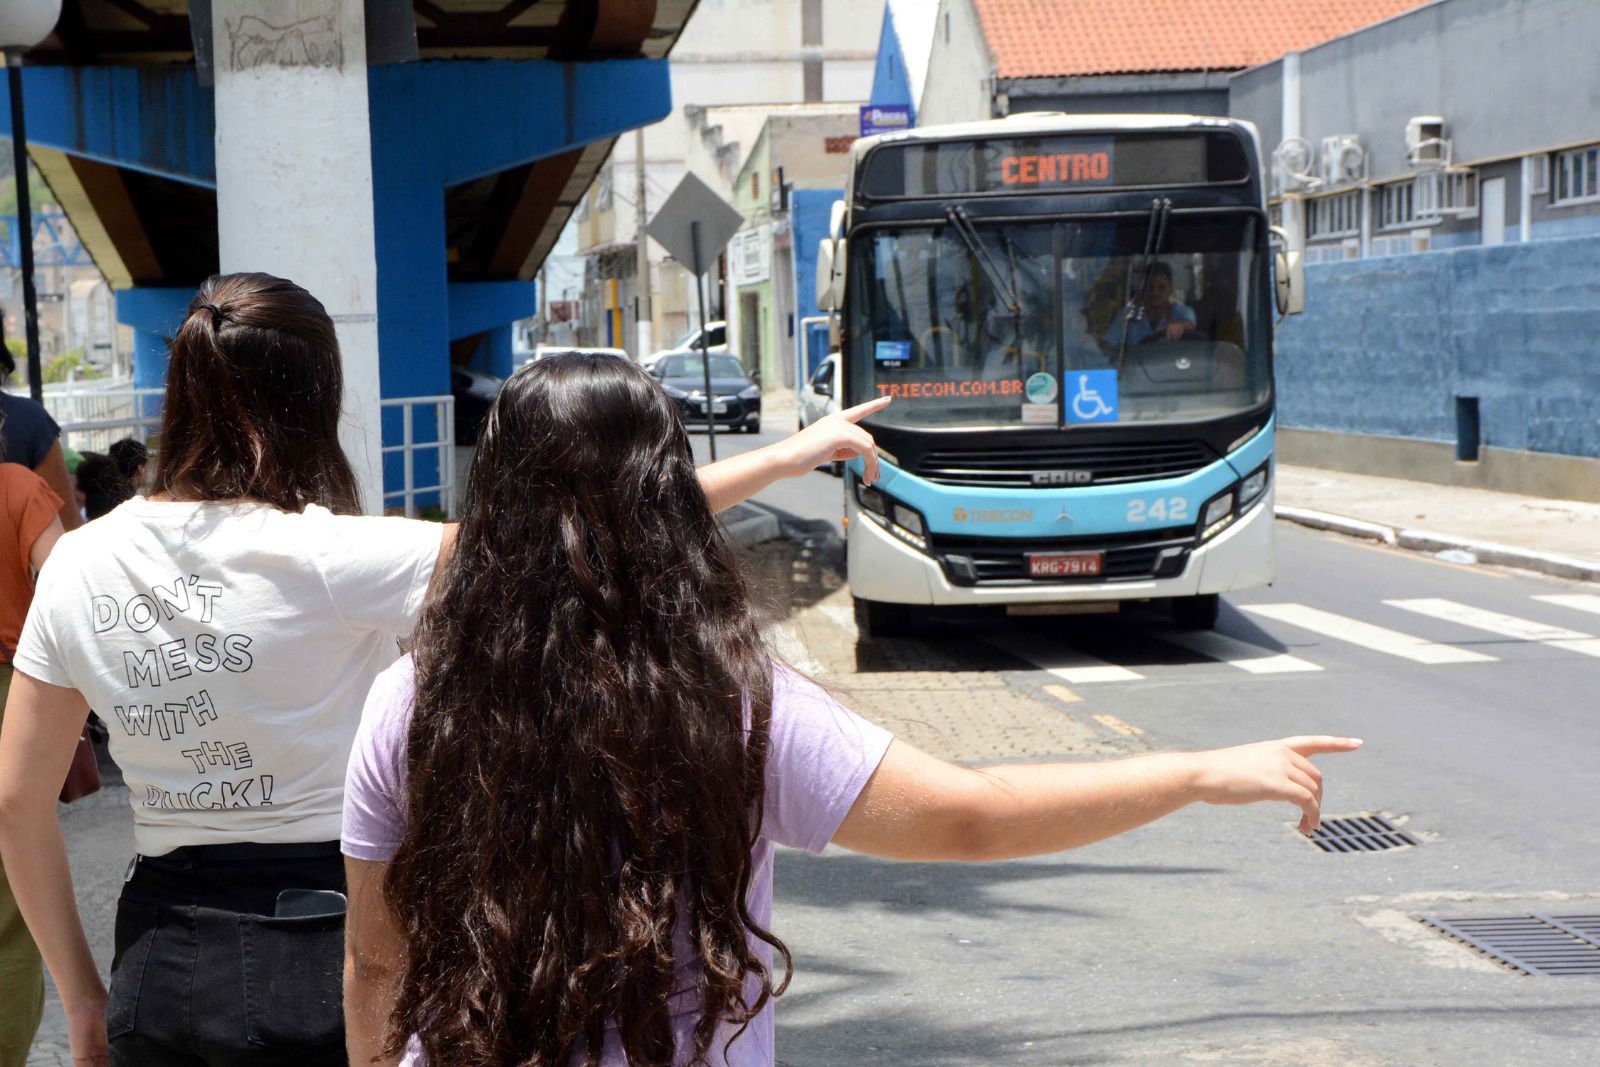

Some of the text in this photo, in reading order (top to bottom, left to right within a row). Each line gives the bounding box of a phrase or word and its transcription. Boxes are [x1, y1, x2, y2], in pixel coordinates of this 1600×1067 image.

[1001, 152, 1109, 185] CENTRO
[1126, 496, 1189, 523] 242
[91, 574, 222, 633] DON'T
[123, 633, 254, 688] MESS
[114, 690, 218, 741] WITH
[181, 741, 253, 774] THE
